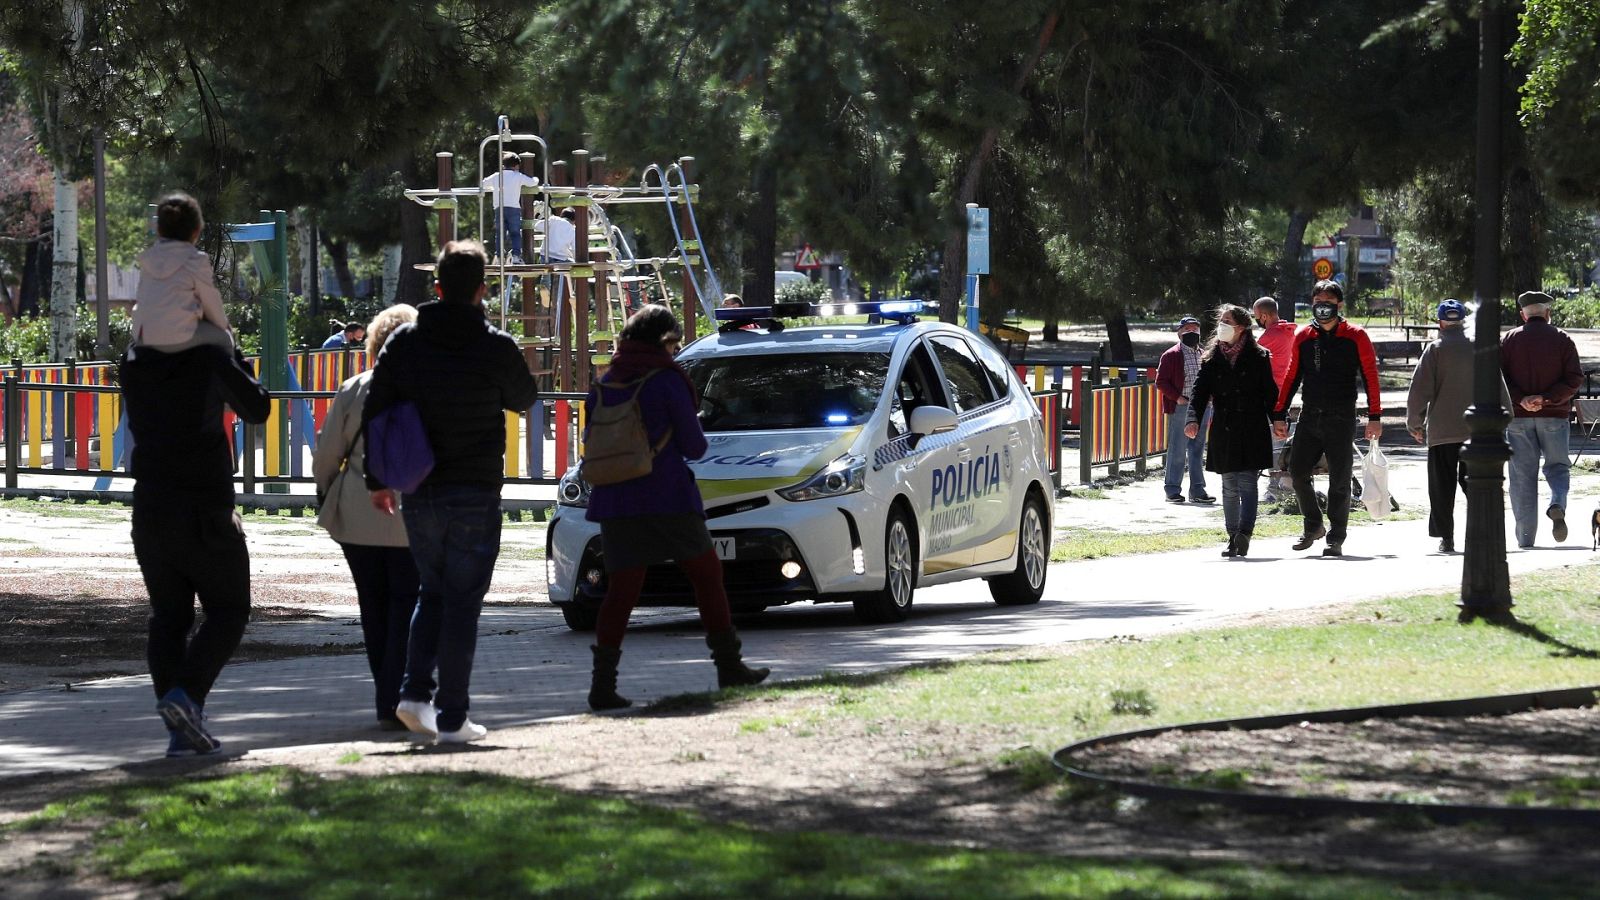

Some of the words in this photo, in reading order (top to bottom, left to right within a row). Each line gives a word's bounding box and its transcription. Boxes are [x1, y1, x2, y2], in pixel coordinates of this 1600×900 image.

[930, 444, 1000, 511] POLICÍA
[930, 503, 975, 536] MUNICIPAL
[928, 534, 952, 553] MADRID
